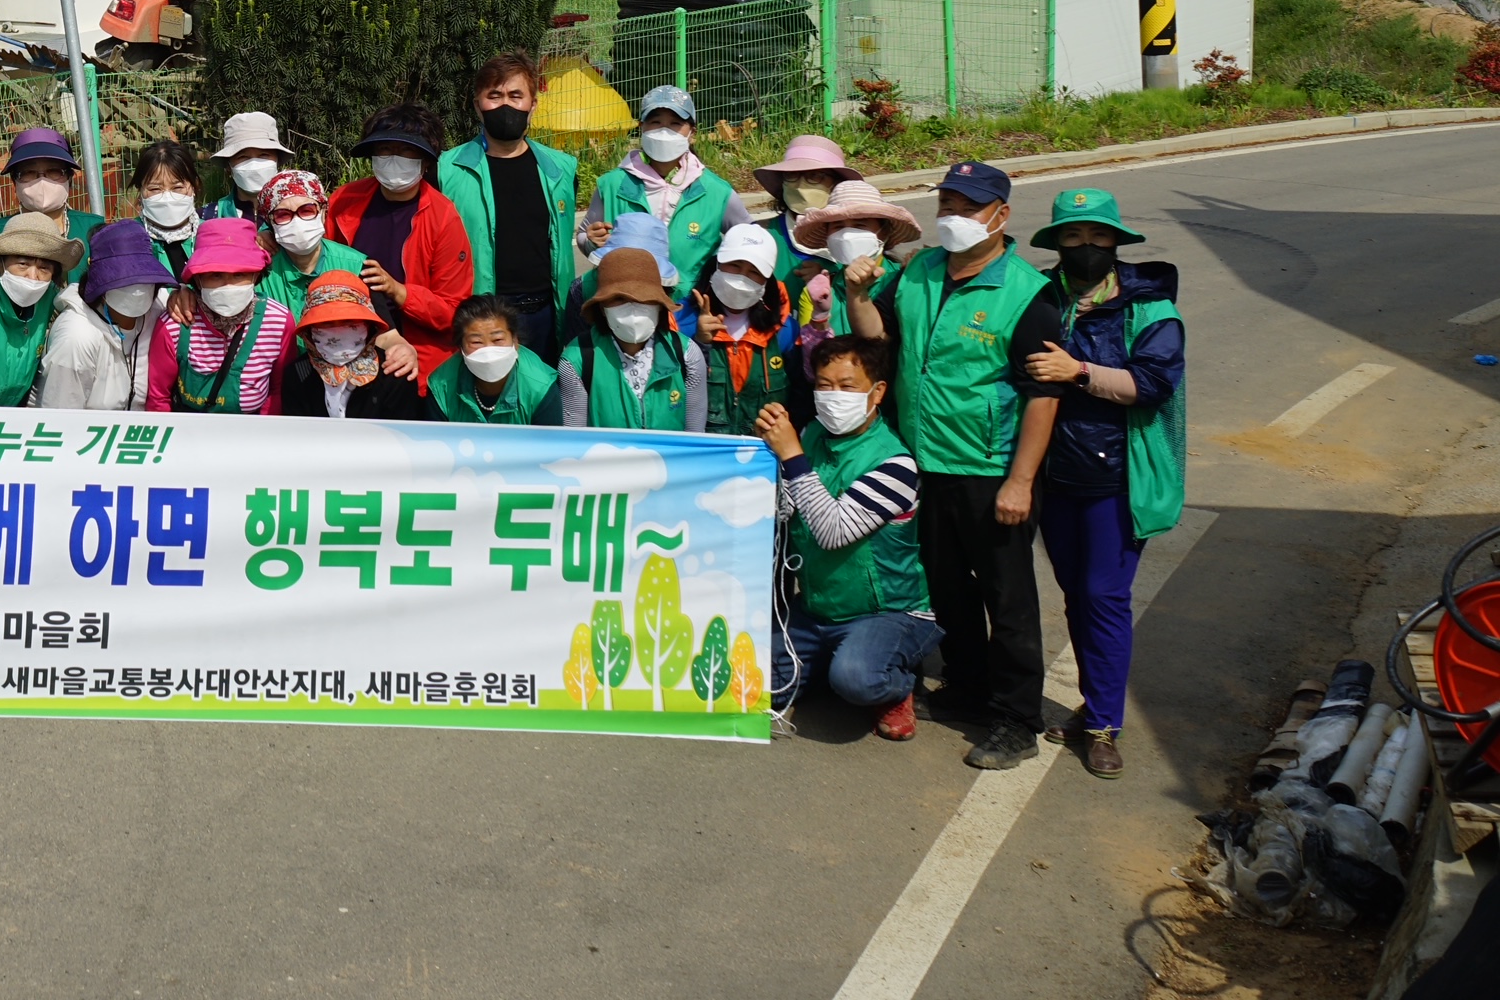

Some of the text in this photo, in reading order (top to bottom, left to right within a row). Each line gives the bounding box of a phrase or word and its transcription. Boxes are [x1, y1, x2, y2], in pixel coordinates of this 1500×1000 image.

[76, 425, 174, 464] 기쁨!
[69, 485, 209, 587] 하면
[244, 487, 457, 591] 행복도
[489, 492, 685, 593] 두배~
[1, 666, 354, 704] 새마을교통봉사대안산지대,
[365, 671, 537, 705] 새마을후원회
